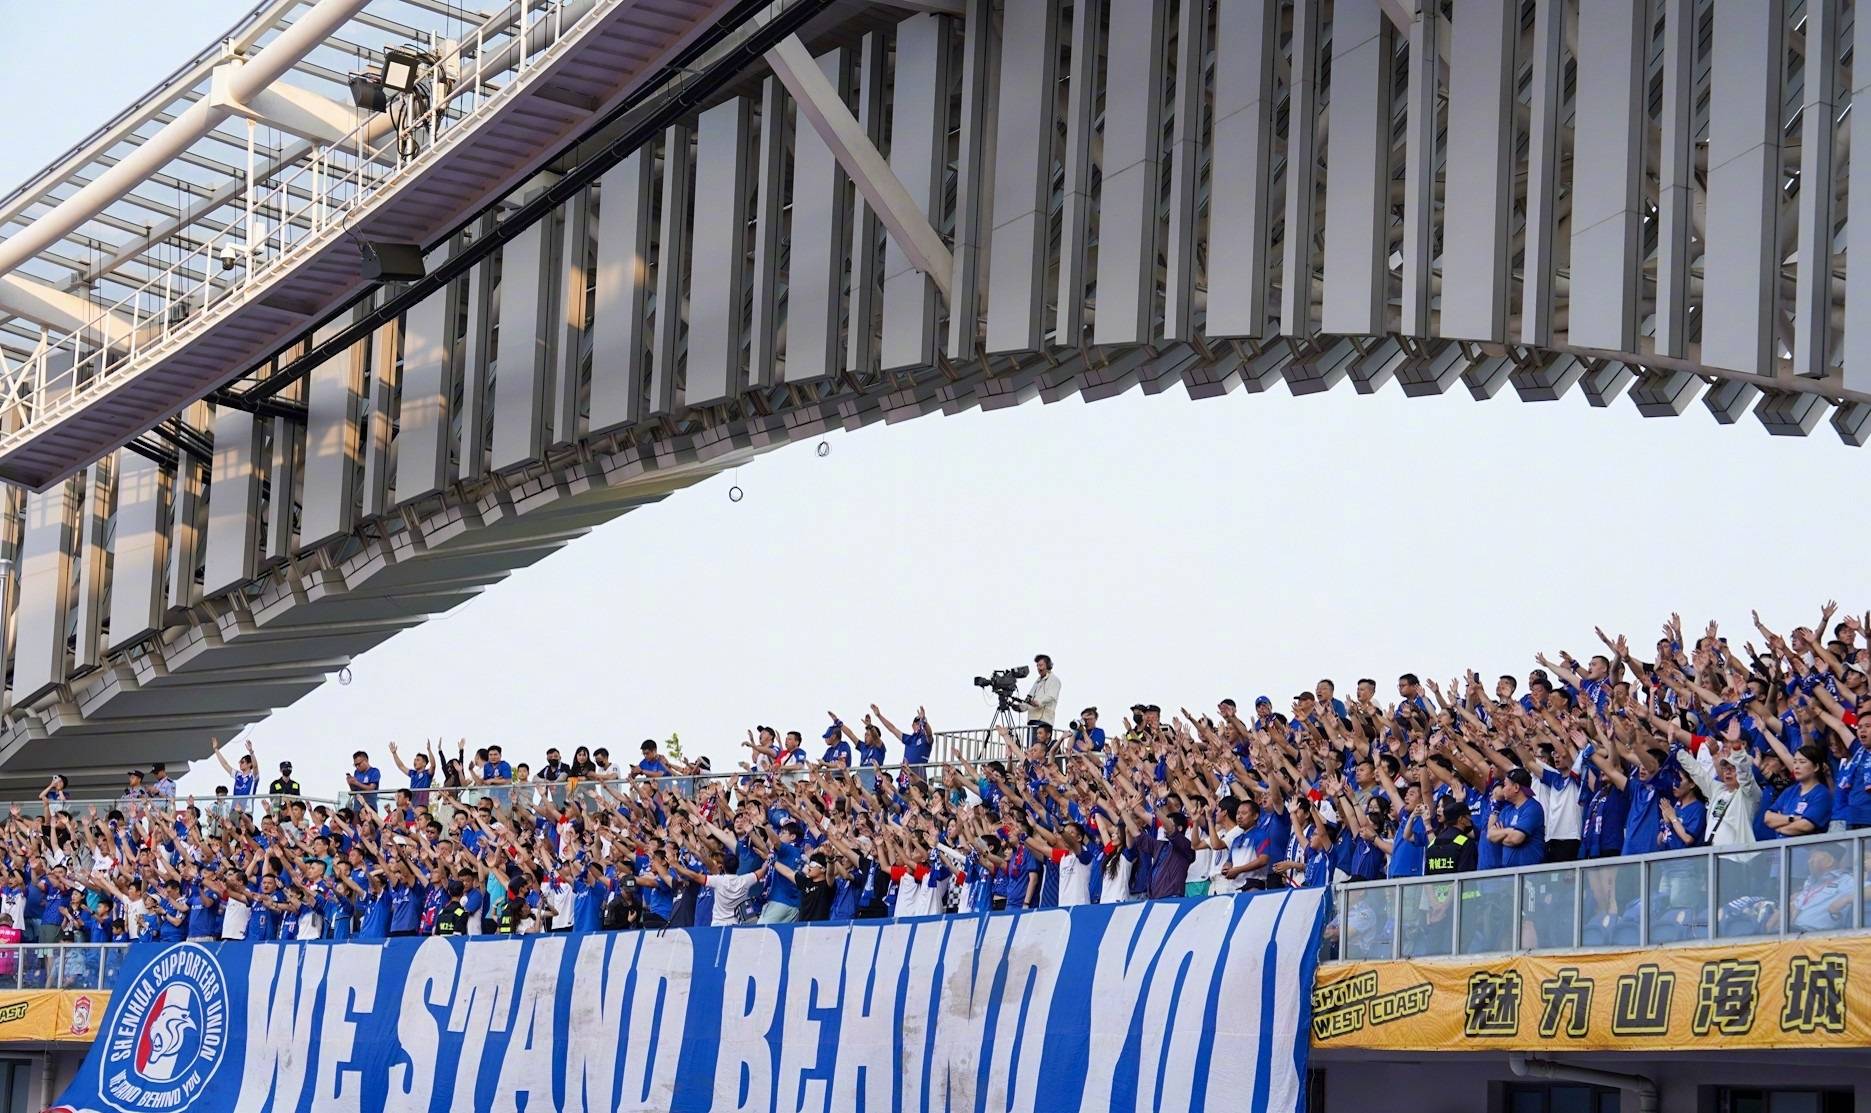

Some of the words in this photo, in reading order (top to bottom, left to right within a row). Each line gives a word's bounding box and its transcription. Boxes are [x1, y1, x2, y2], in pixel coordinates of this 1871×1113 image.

[110, 978, 156, 1062] SHENHUA
[153, 951, 220, 1002] SUPPORTERS
[200, 999, 222, 1062] UNION
[234, 944, 383, 1113] WE
[383, 928, 696, 1113] STAND
[708, 910, 1071, 1113] BEHIND
[1081, 886, 1324, 1113] YOU
[1313, 1003, 1366, 1039] WEST
[1369, 982, 1433, 1025] COAST
[1465, 953, 1848, 1037] 魅力山海城
[136, 1088, 181, 1108] BEHIND
[182, 1070, 201, 1097] YOU
